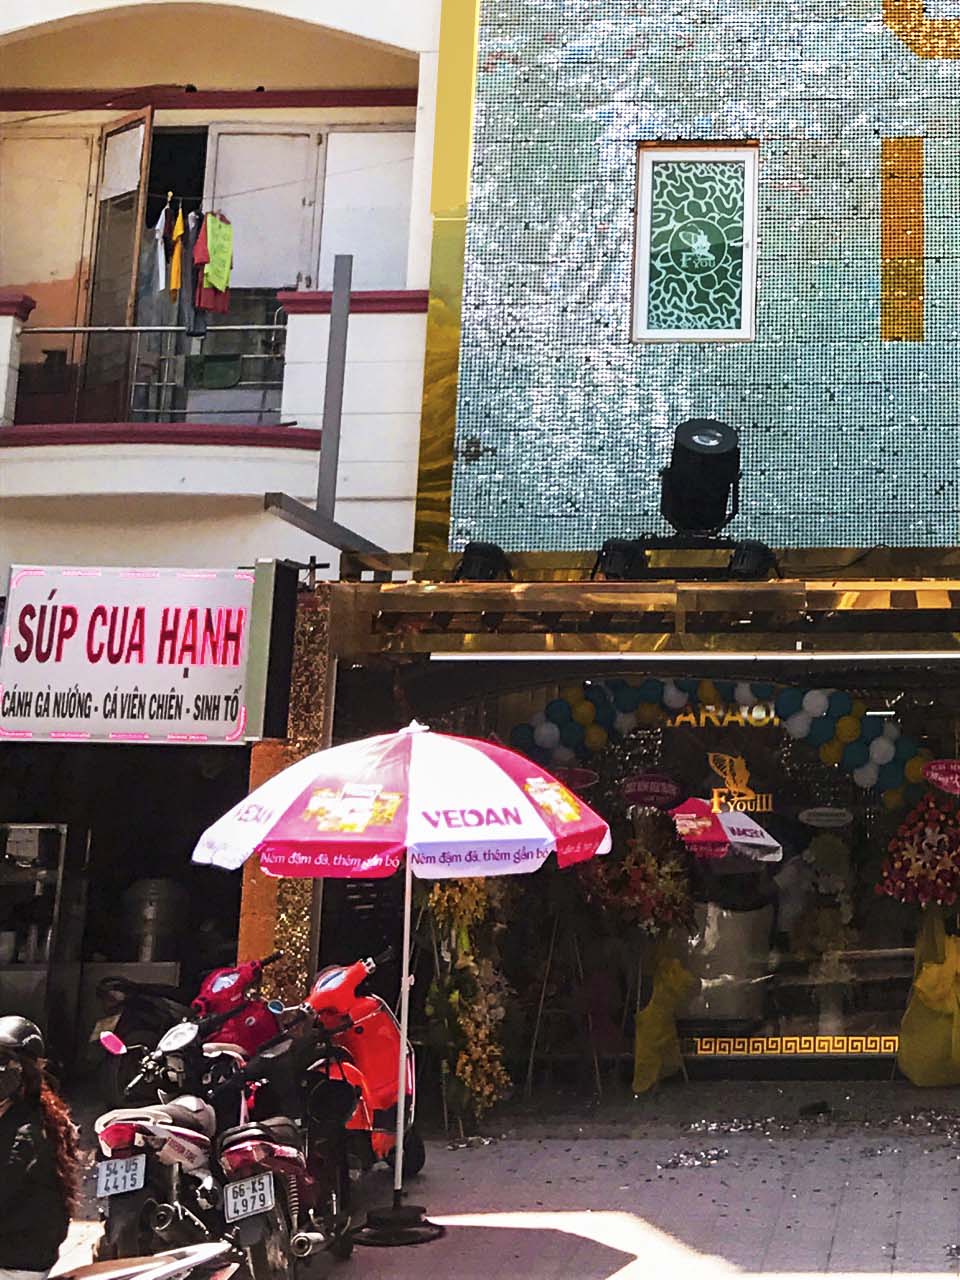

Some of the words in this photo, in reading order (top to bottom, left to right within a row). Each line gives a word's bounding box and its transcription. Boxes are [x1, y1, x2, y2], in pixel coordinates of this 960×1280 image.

[13, 588, 79, 664] SÚP
[86, 604, 147, 664] CUA
[156, 606, 247, 679] HẠNH
[1, 684, 33, 720] CÁNH
[35, 685, 50, 719] GÀ
[52, 684, 92, 720] NƯỚNG
[103, 686, 119, 720] CÁ
[120, 686, 146, 720] VIÊN
[150, 687, 183, 721] CHIÊN
[193, 694, 221, 721] SINH
[422, 806, 523, 829] VEDAN
[233, 1193, 266, 1216] 4979
